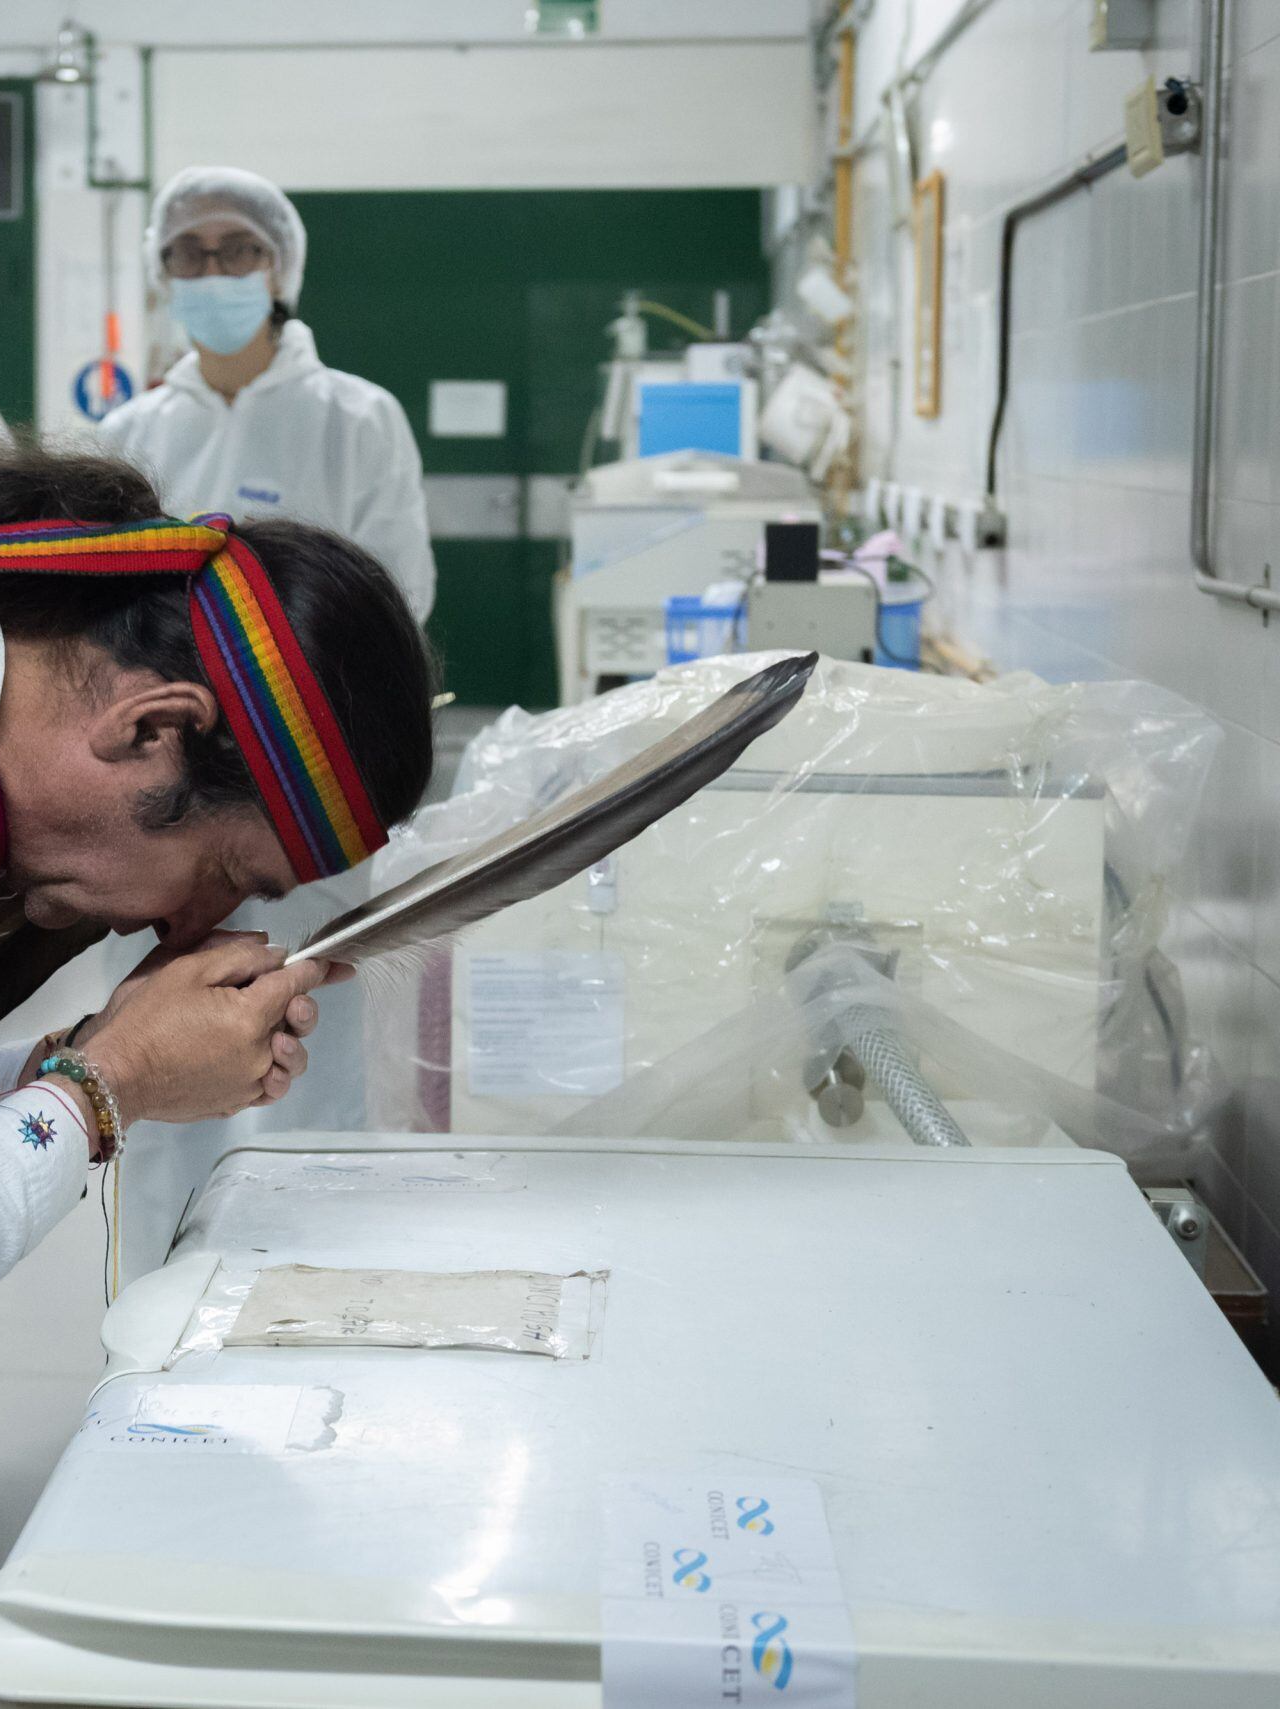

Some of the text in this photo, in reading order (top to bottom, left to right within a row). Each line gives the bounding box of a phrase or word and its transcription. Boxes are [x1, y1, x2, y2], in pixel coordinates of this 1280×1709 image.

[110, 1435, 232, 1444] CONICET
[707, 1490, 729, 1540] CONICET
[643, 1541, 664, 1599] CONICET
[720, 1603, 742, 1704] CONICET
